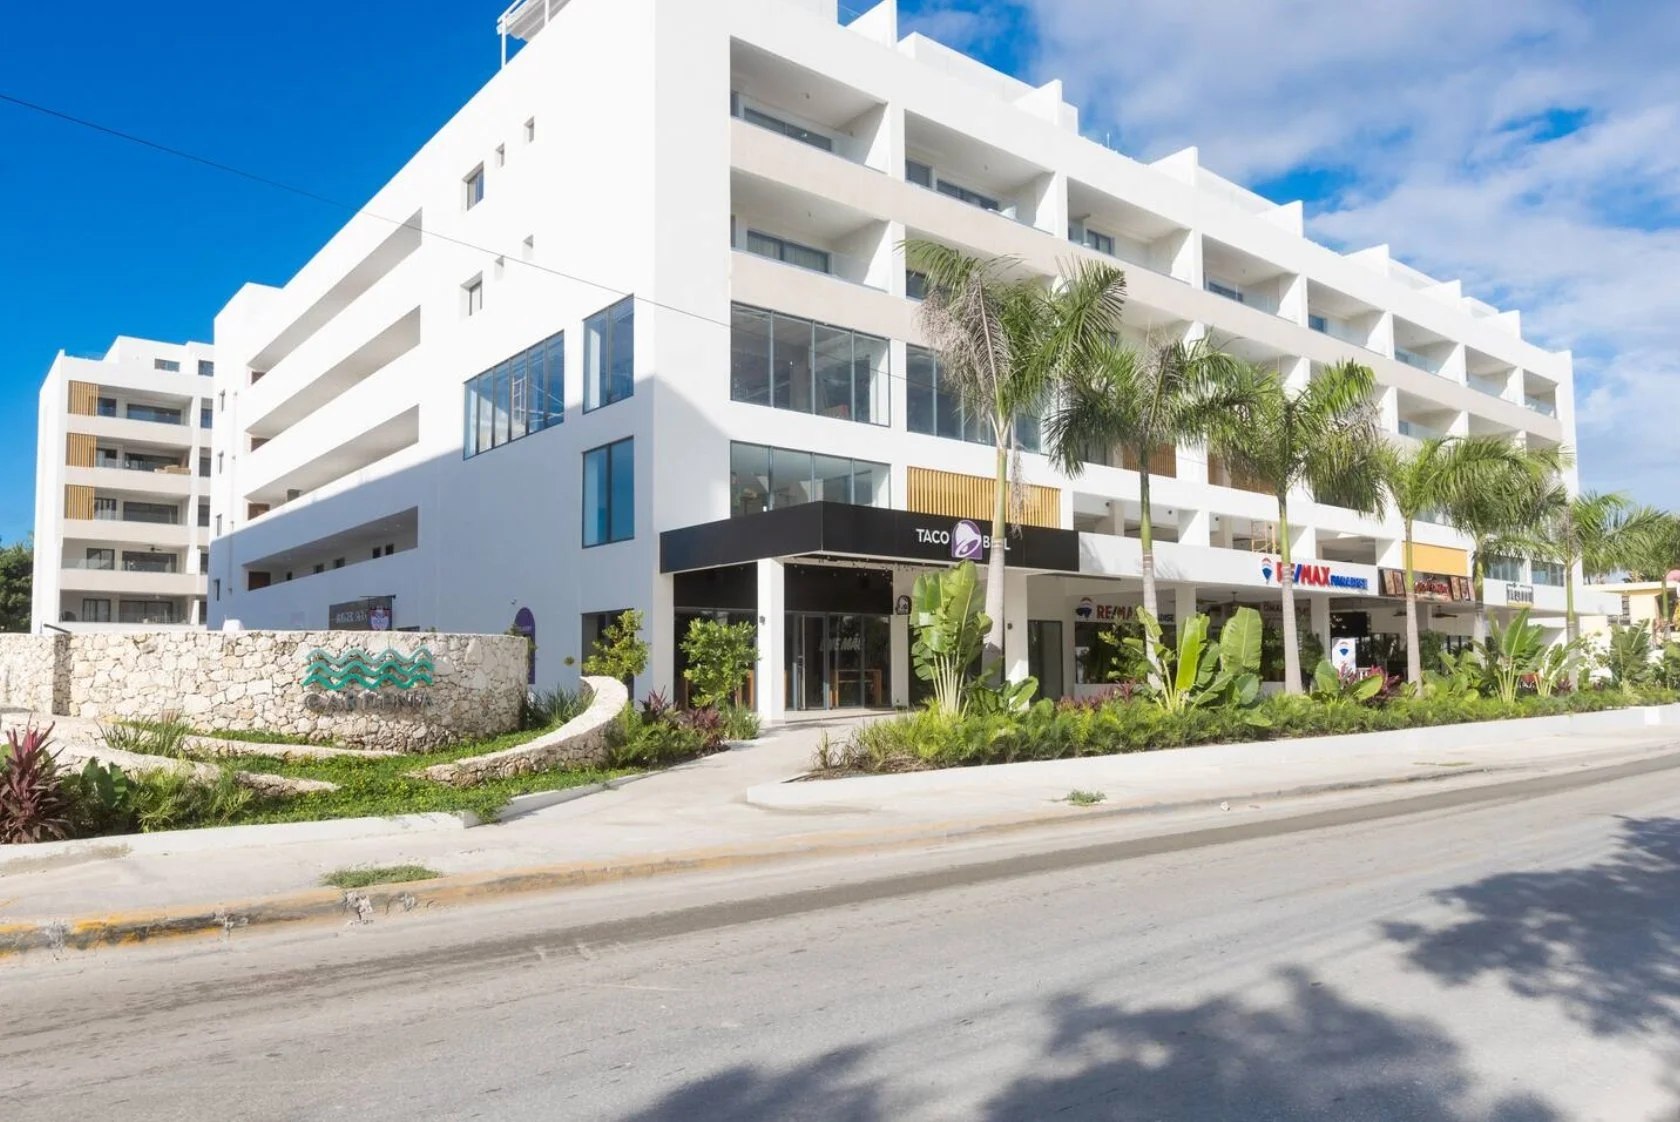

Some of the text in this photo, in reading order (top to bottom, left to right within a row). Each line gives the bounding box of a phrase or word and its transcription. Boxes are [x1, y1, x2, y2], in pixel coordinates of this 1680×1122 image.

[915, 528, 1011, 551] TACO BL
[1096, 604, 1134, 620] RE/MA
